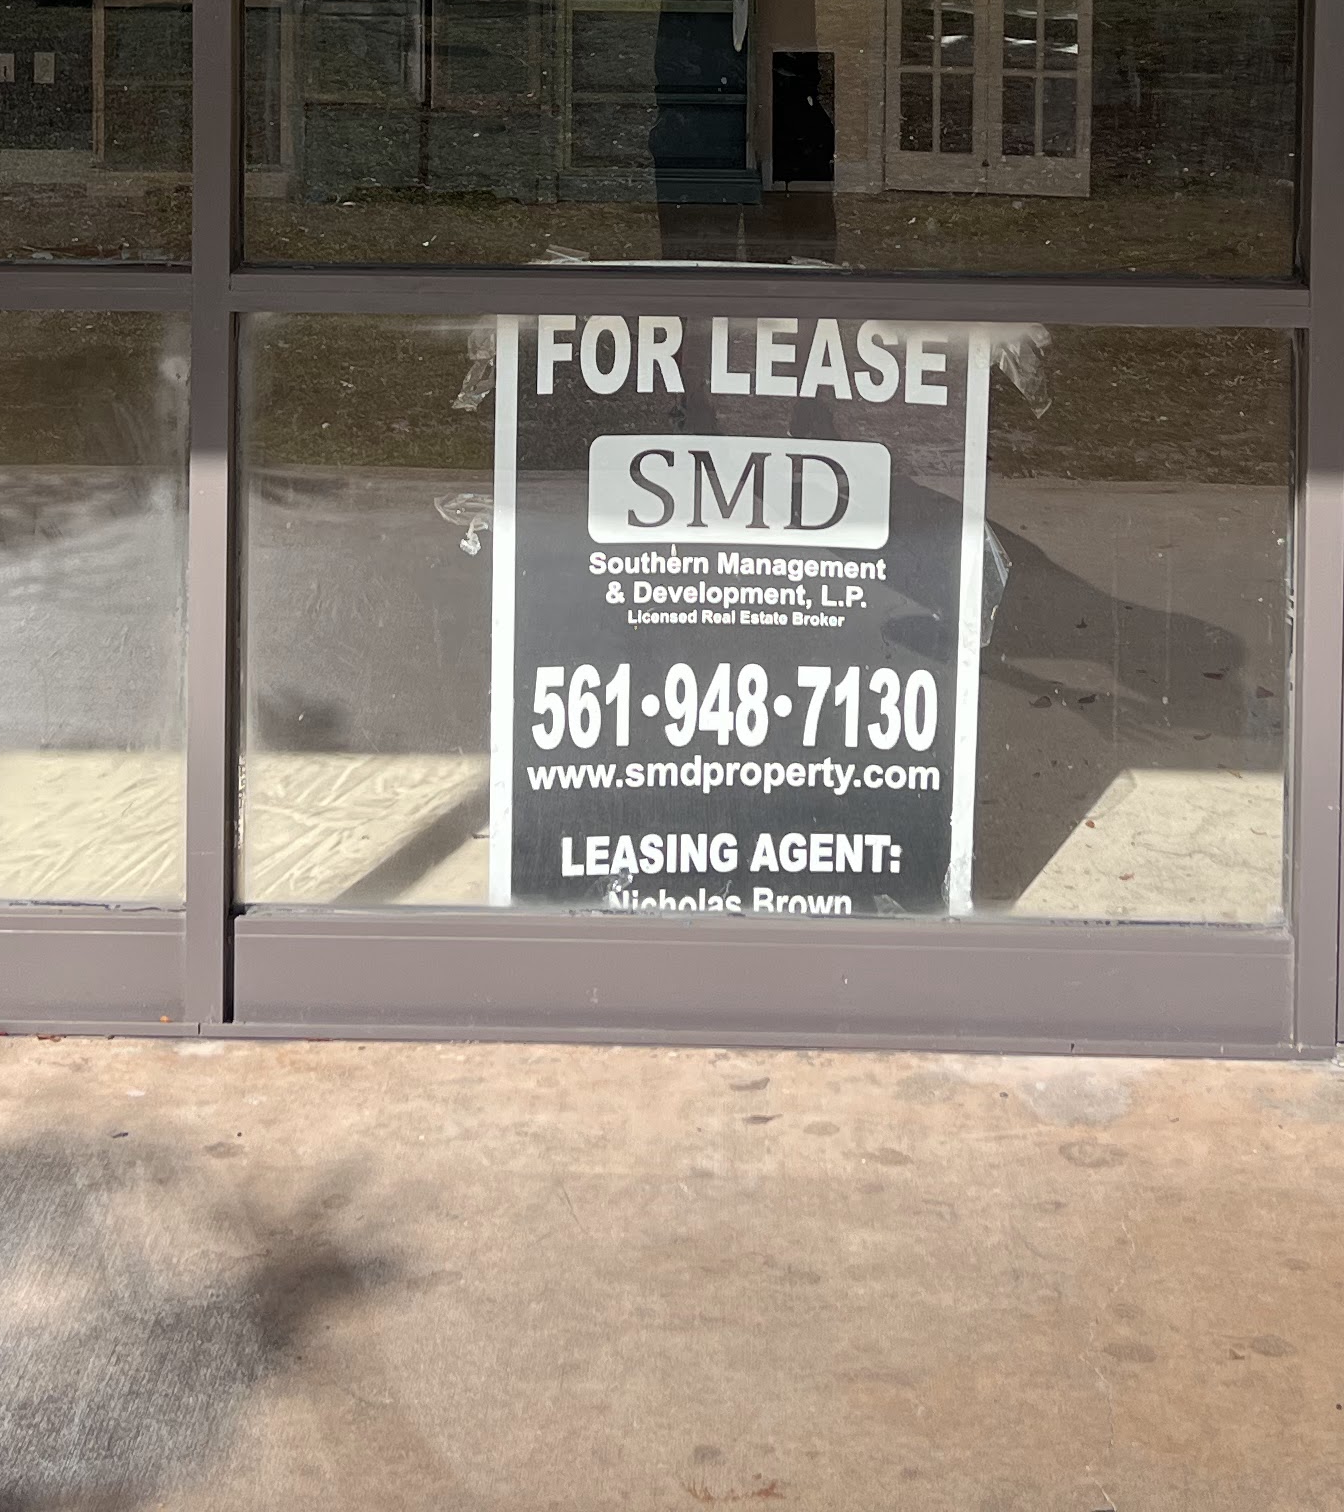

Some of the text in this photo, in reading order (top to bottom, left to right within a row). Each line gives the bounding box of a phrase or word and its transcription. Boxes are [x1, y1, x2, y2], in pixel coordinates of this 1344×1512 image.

[536, 315, 948, 406] FOR LEASE
[627, 449, 850, 531] SMD
[588, 552, 887, 581] Southern Management
[606, 581, 867, 609] & Development, L.P.
[628, 609, 845, 627] Licensed Real Estate Broker
[526, 755, 940, 795] www.smdproperty.com
[561, 833, 902, 877] LEASING AGENT:
